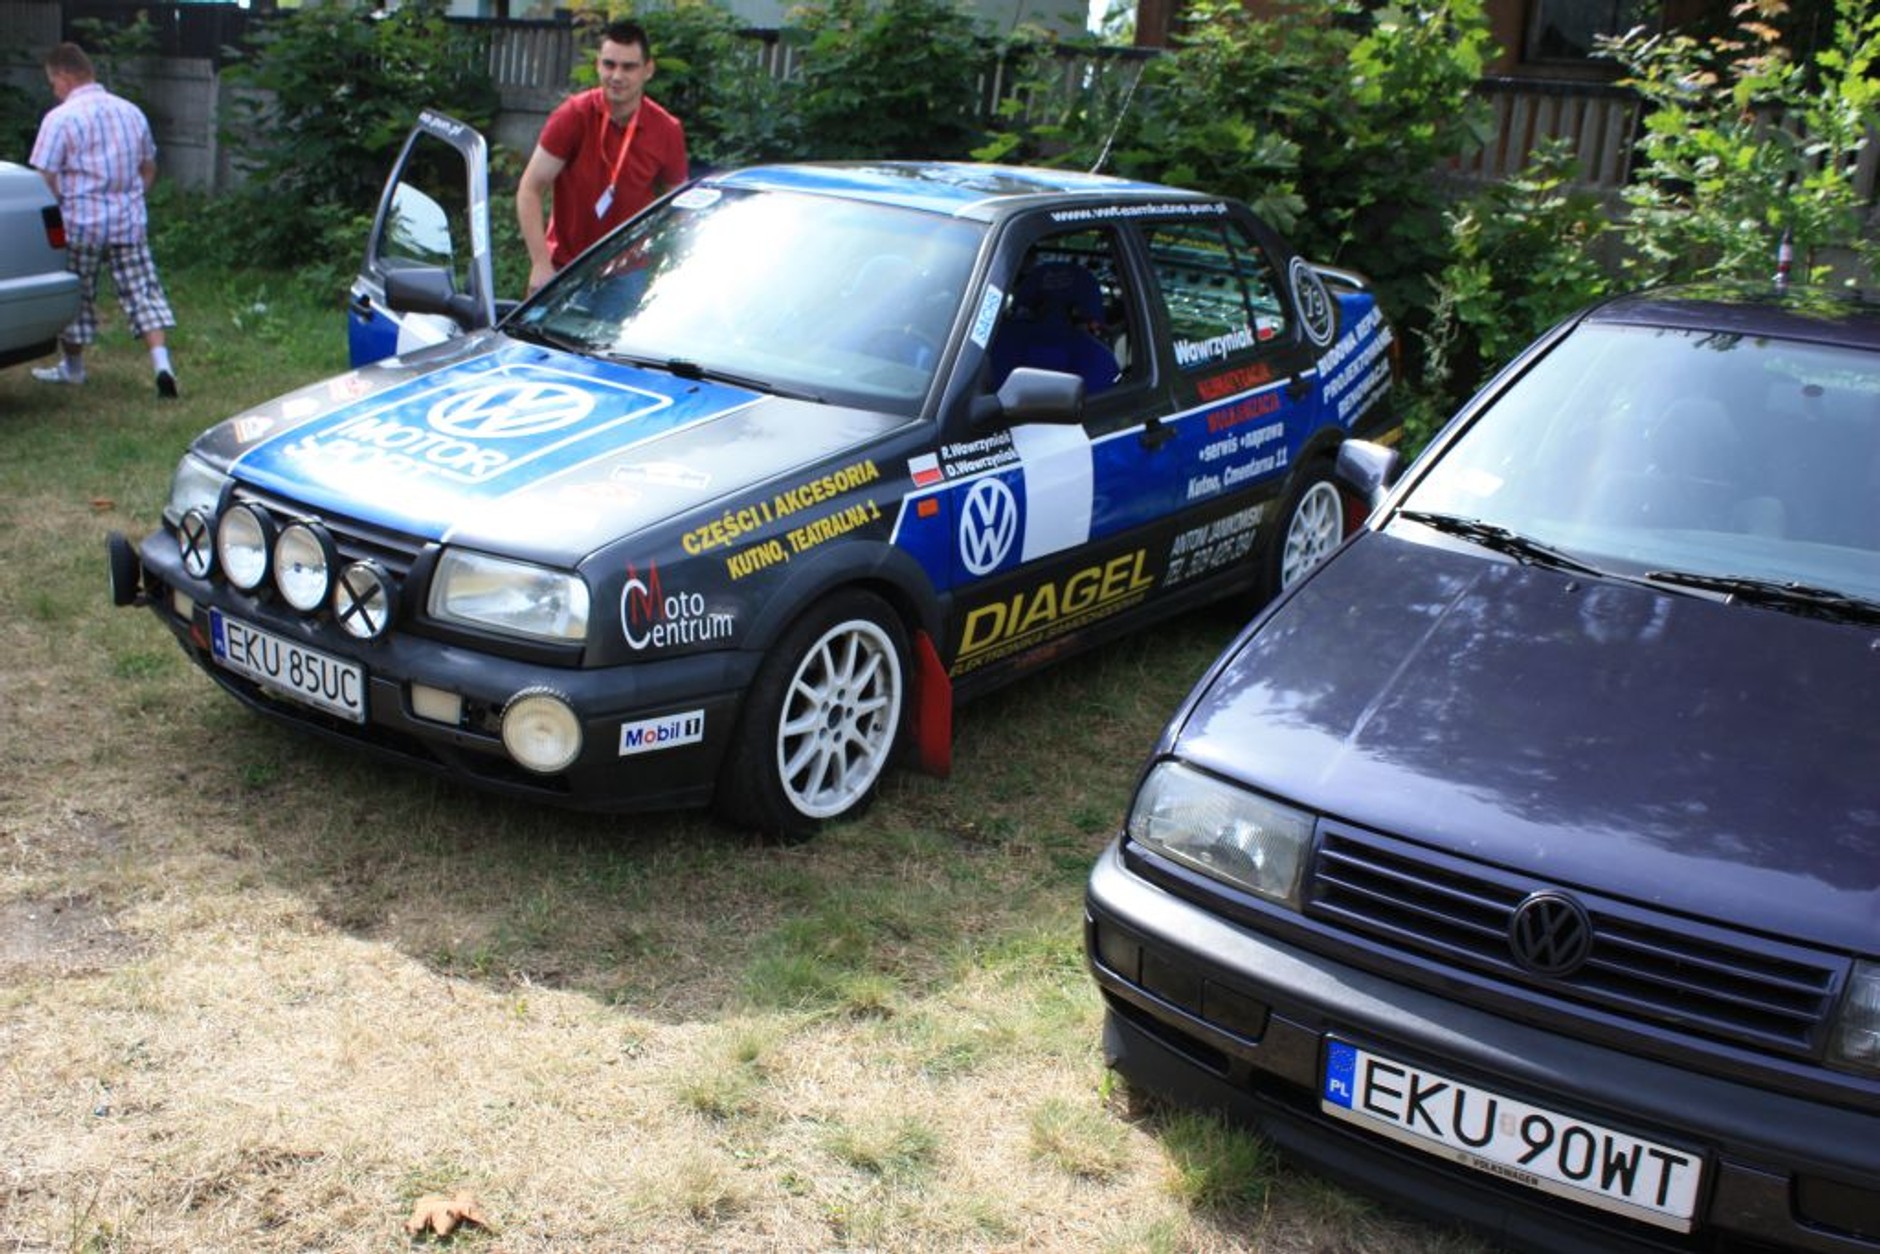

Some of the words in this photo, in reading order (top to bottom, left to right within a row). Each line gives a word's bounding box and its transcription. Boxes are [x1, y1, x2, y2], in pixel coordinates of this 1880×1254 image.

[1173, 323, 1255, 366] Wawrzyniak
[337, 418, 510, 477] MOTOR
[682, 507, 762, 556] CZĘŚCI
[760, 501, 774, 523] I
[774, 459, 880, 518] AKCESORIA
[726, 540, 790, 581] KUTNO,
[786, 504, 870, 554] TEATRALNA
[868, 499, 881, 520] 1
[620, 578, 735, 650] Centrum
[624, 558, 705, 625] Moto
[958, 548, 1154, 656] DIAGEL
[227, 623, 281, 677] EKU
[290, 650, 358, 708] 85UC
[626, 721, 681, 748] Mobil
[1330, 1078, 1350, 1098] PL
[1363, 1059, 1498, 1148] EKU
[1517, 1113, 1689, 1207] 90WT
[1472, 1156, 1540, 1187] VOLKSWAGEN
